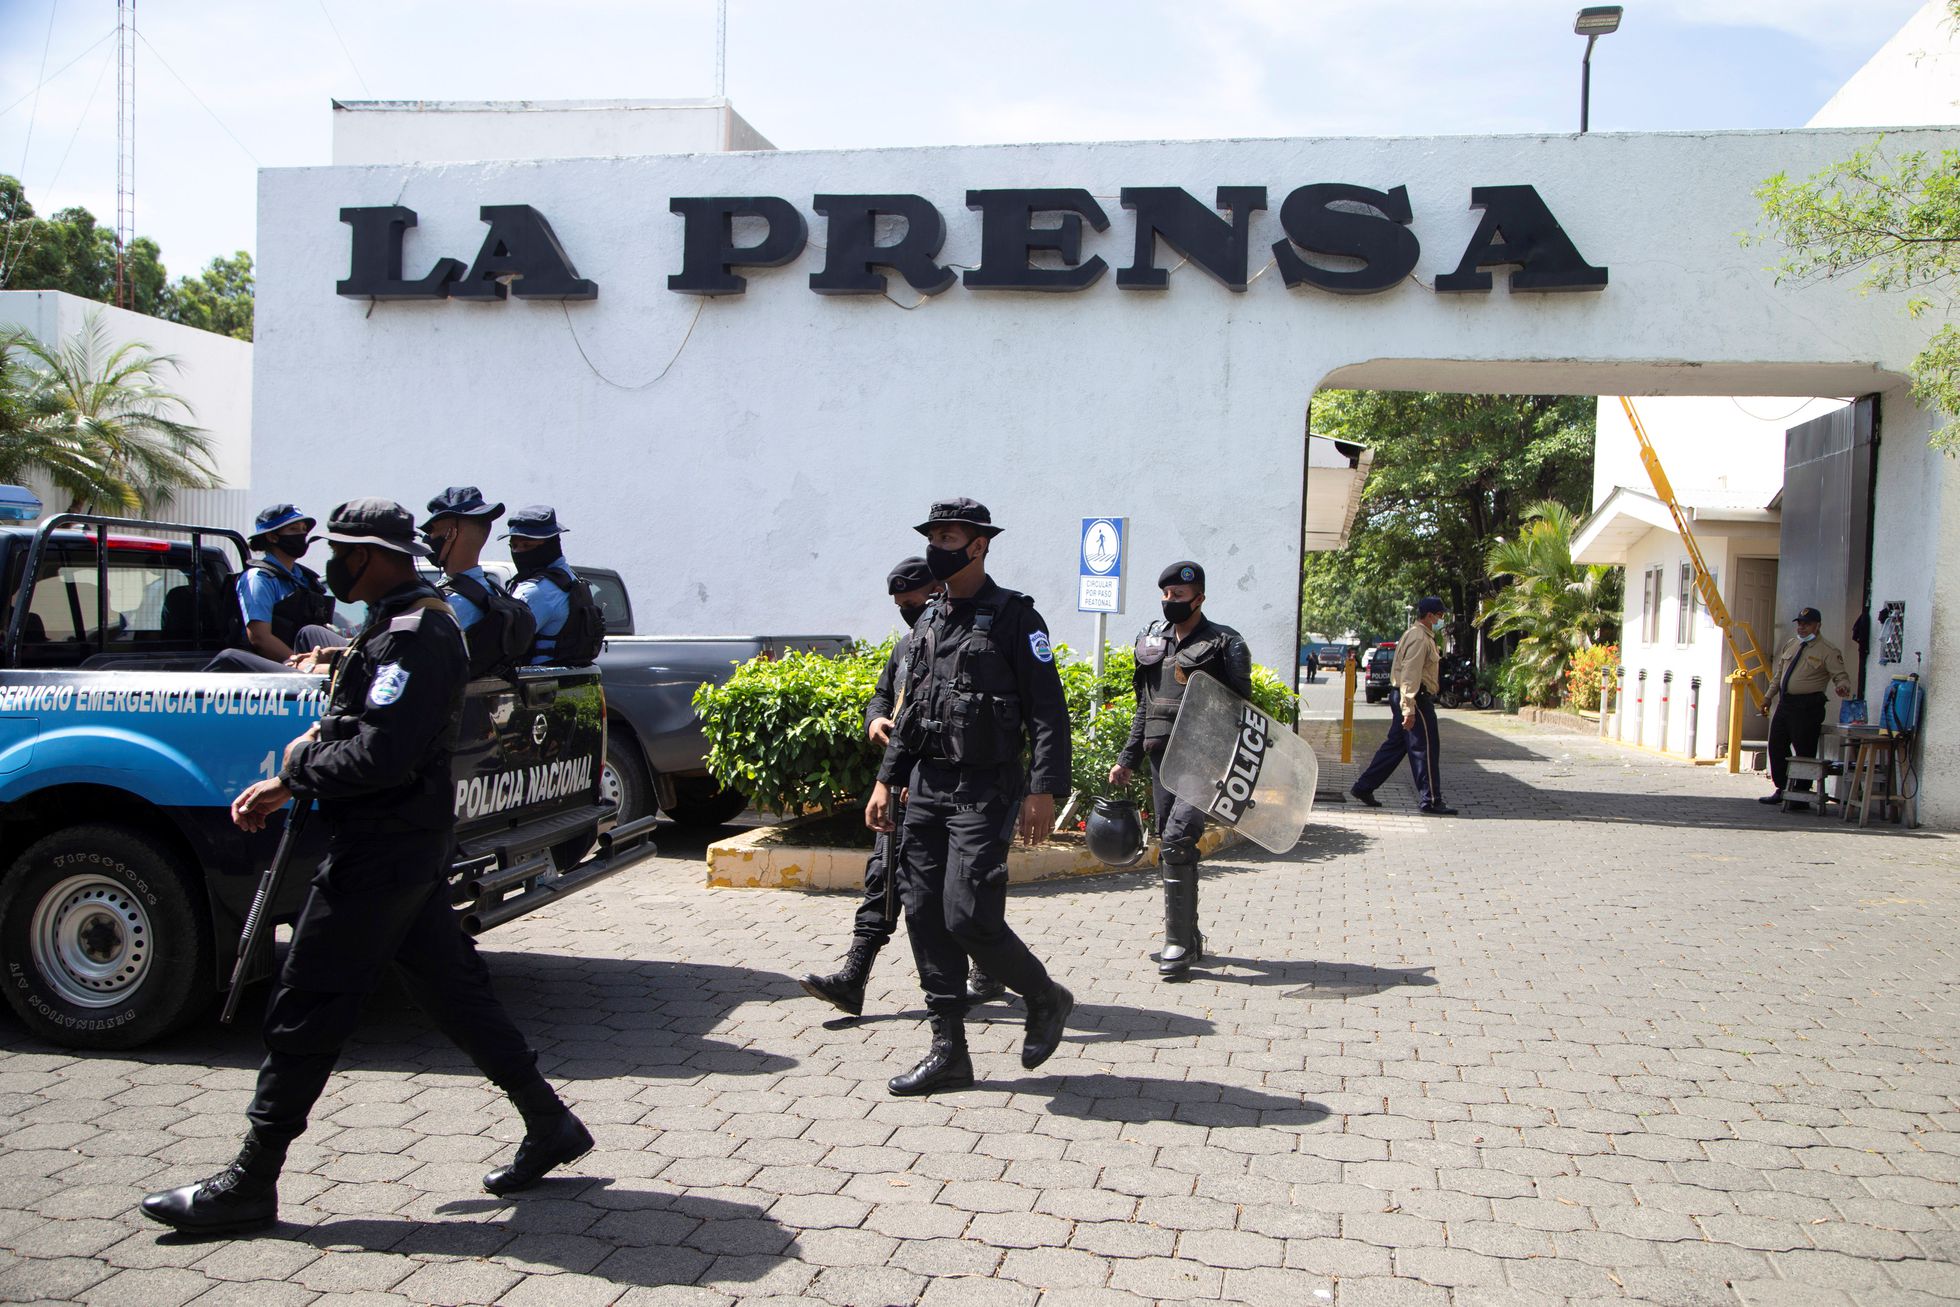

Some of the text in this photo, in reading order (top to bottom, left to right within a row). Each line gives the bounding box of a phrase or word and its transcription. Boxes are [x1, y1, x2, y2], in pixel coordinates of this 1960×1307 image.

[336, 183, 1607, 300] LA PRENSA
[1085, 589, 1112, 598] POR PASO
[1086, 580, 1112, 588] CIRCULAR
[1085, 598, 1112, 607] PEATONAL
[76, 686, 197, 714] EMERGENCIA
[202, 688, 289, 716] POLICIAL
[1214, 707, 1267, 822] POLICE
[453, 755, 593, 819] POLICIA NACIONAL
[28, 994, 136, 1031] DESTINATION
